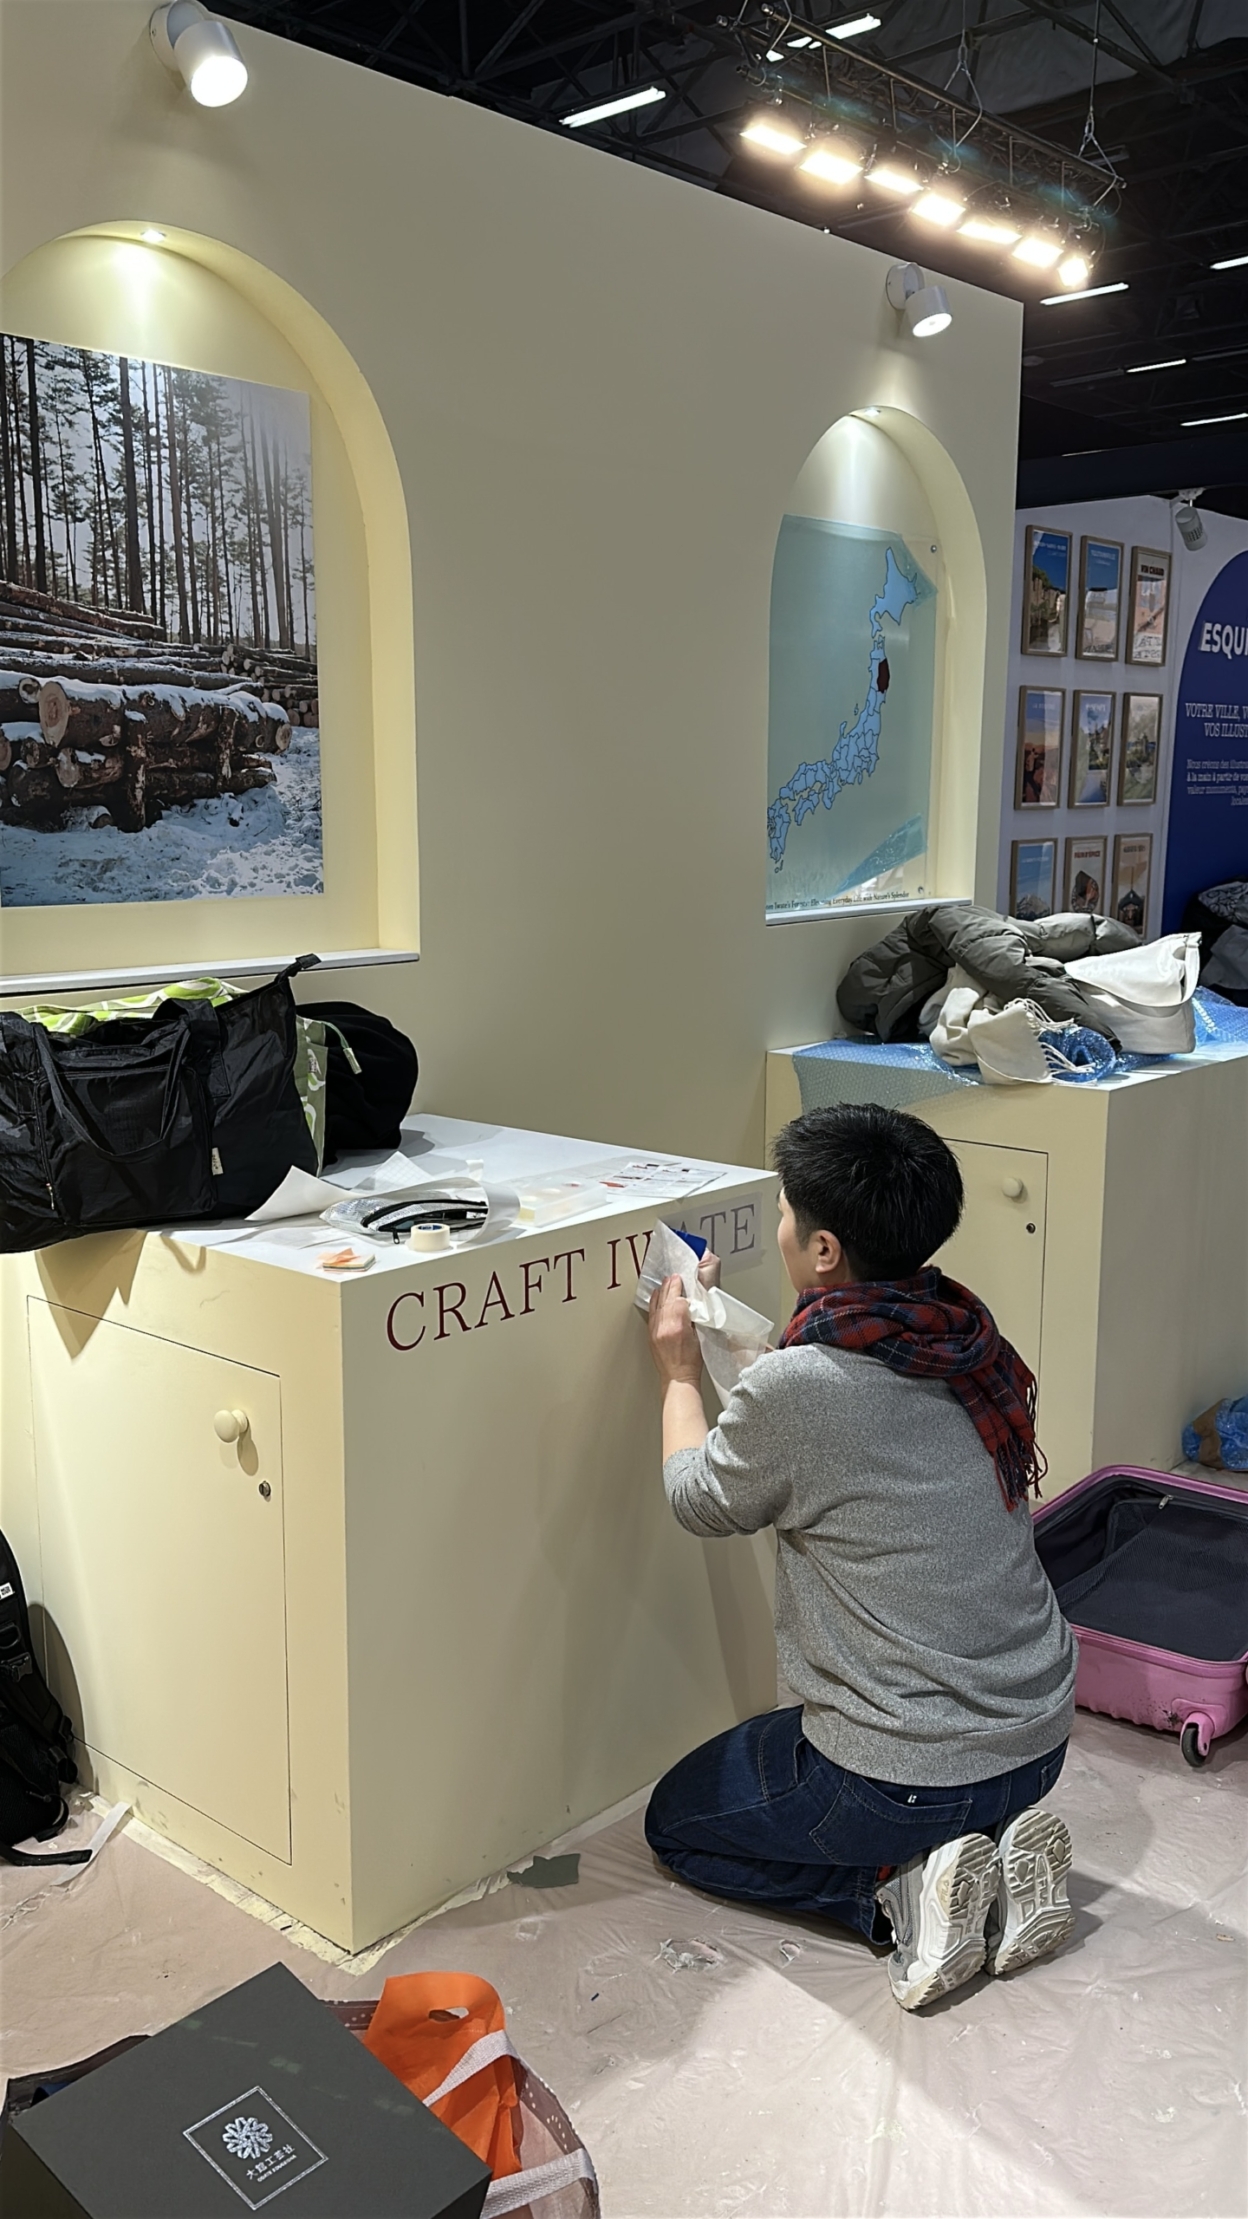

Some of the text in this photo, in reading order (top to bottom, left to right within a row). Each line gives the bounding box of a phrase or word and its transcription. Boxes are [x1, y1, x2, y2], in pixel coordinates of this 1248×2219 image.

[1185, 702, 1213, 718] VOTRE
[1215, 704, 1240, 722] VILLE,
[1204, 722, 1220, 737] VOS
[386, 1249, 586, 1352] CRAFT
